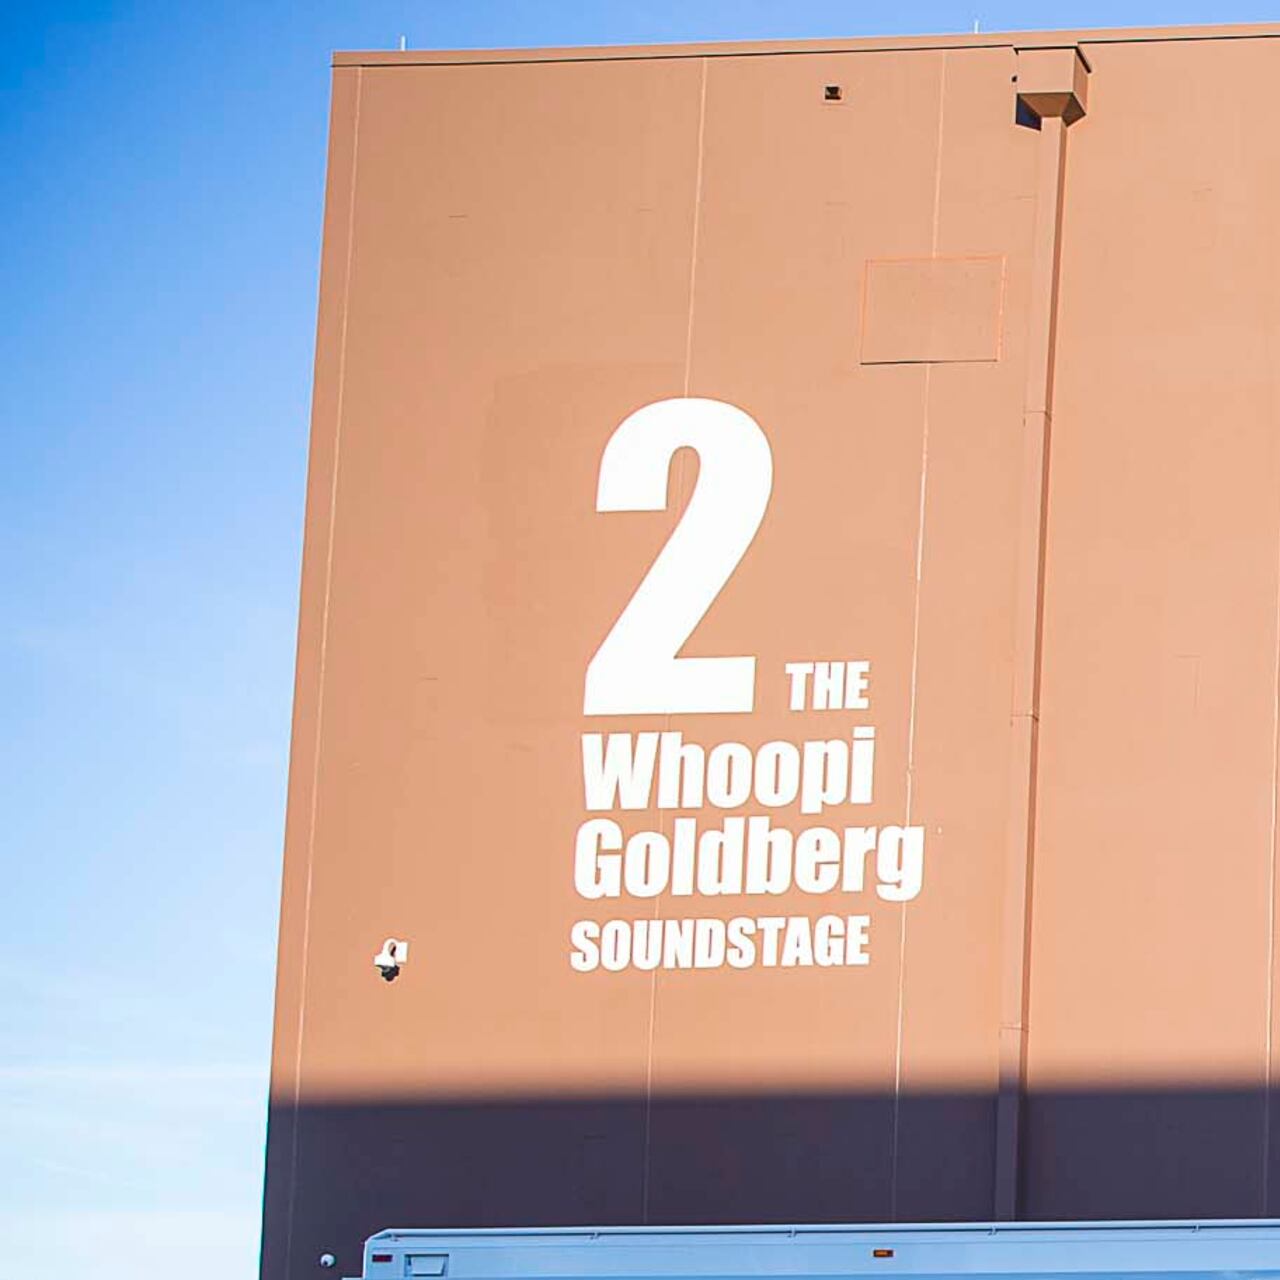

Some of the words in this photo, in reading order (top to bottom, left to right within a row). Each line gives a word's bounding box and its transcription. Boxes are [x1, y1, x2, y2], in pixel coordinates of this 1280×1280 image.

[583, 397, 773, 715] 2
[785, 661, 869, 711] THE
[581, 726, 876, 814] Whoopi
[573, 816, 925, 902] Goldberg
[569, 915, 869, 971] SOUNDSTAGE
